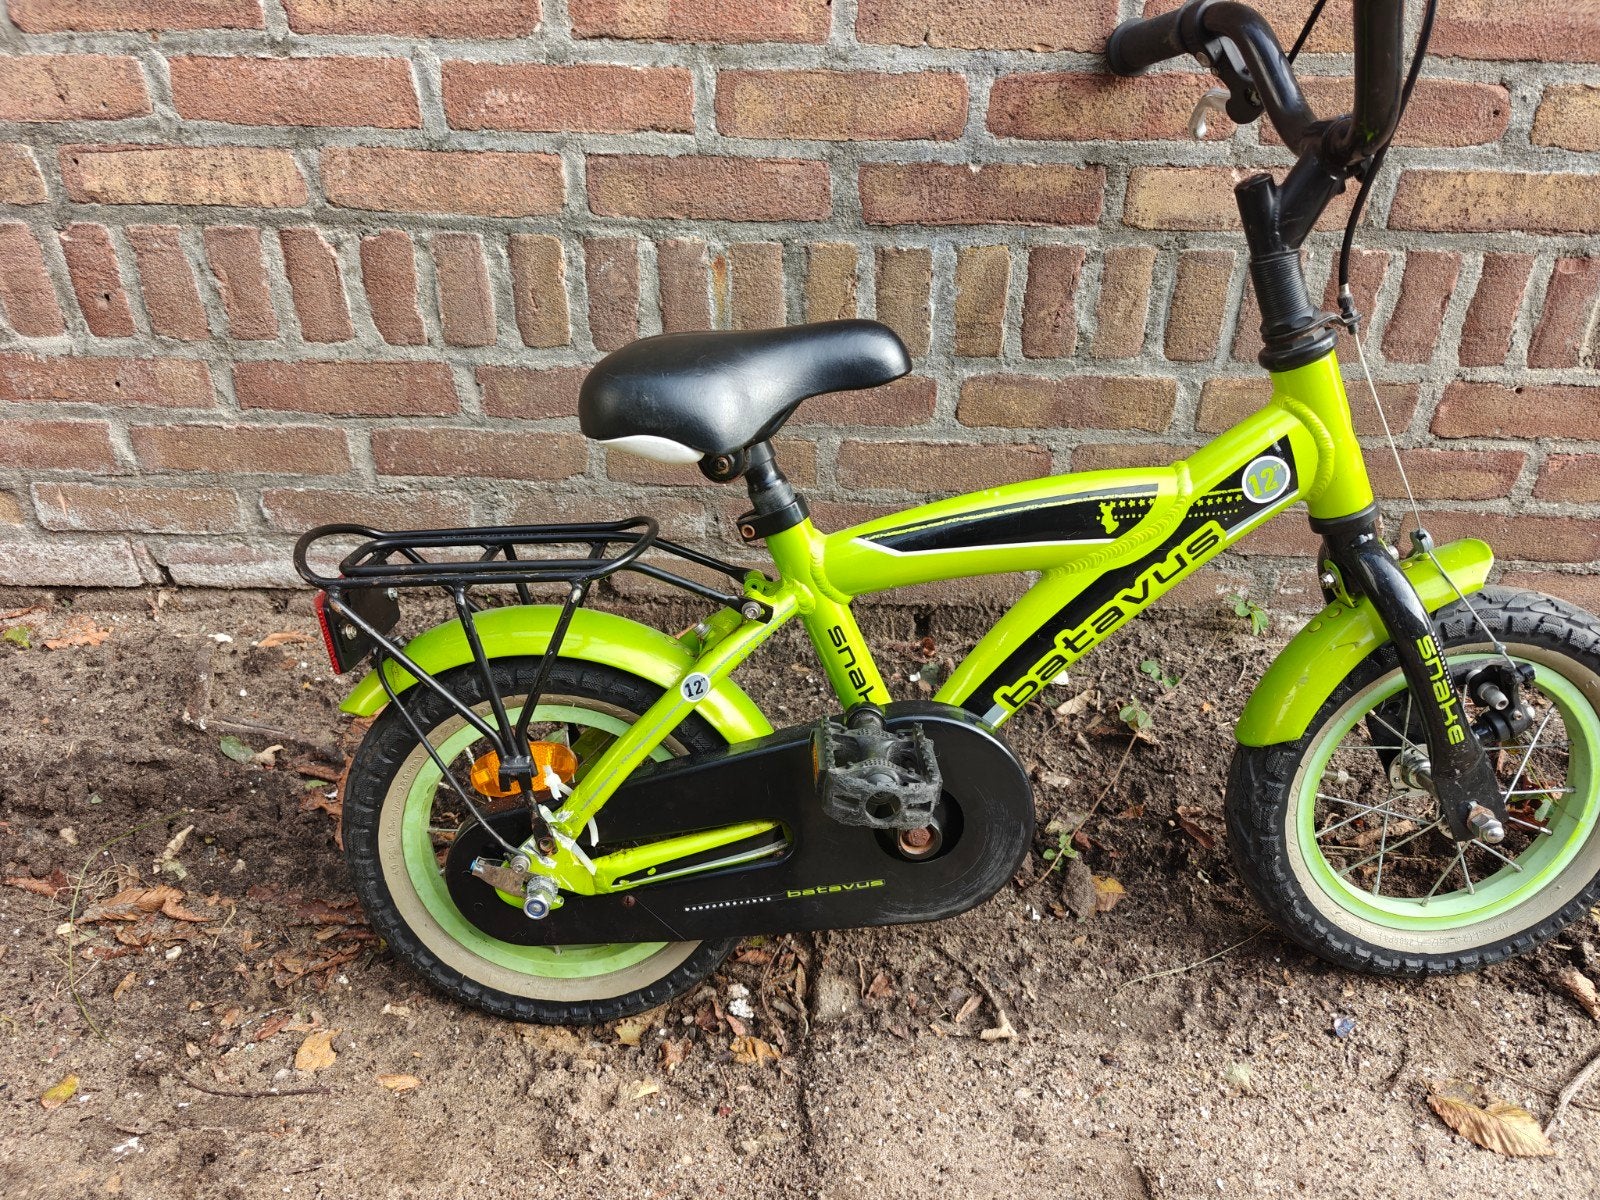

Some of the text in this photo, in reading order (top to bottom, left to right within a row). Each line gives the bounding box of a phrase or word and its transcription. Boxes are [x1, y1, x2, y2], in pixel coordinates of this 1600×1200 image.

[1000, 527, 1221, 708] batavus
[1416, 634, 1466, 746] snake
[786, 879, 885, 898] batavus
